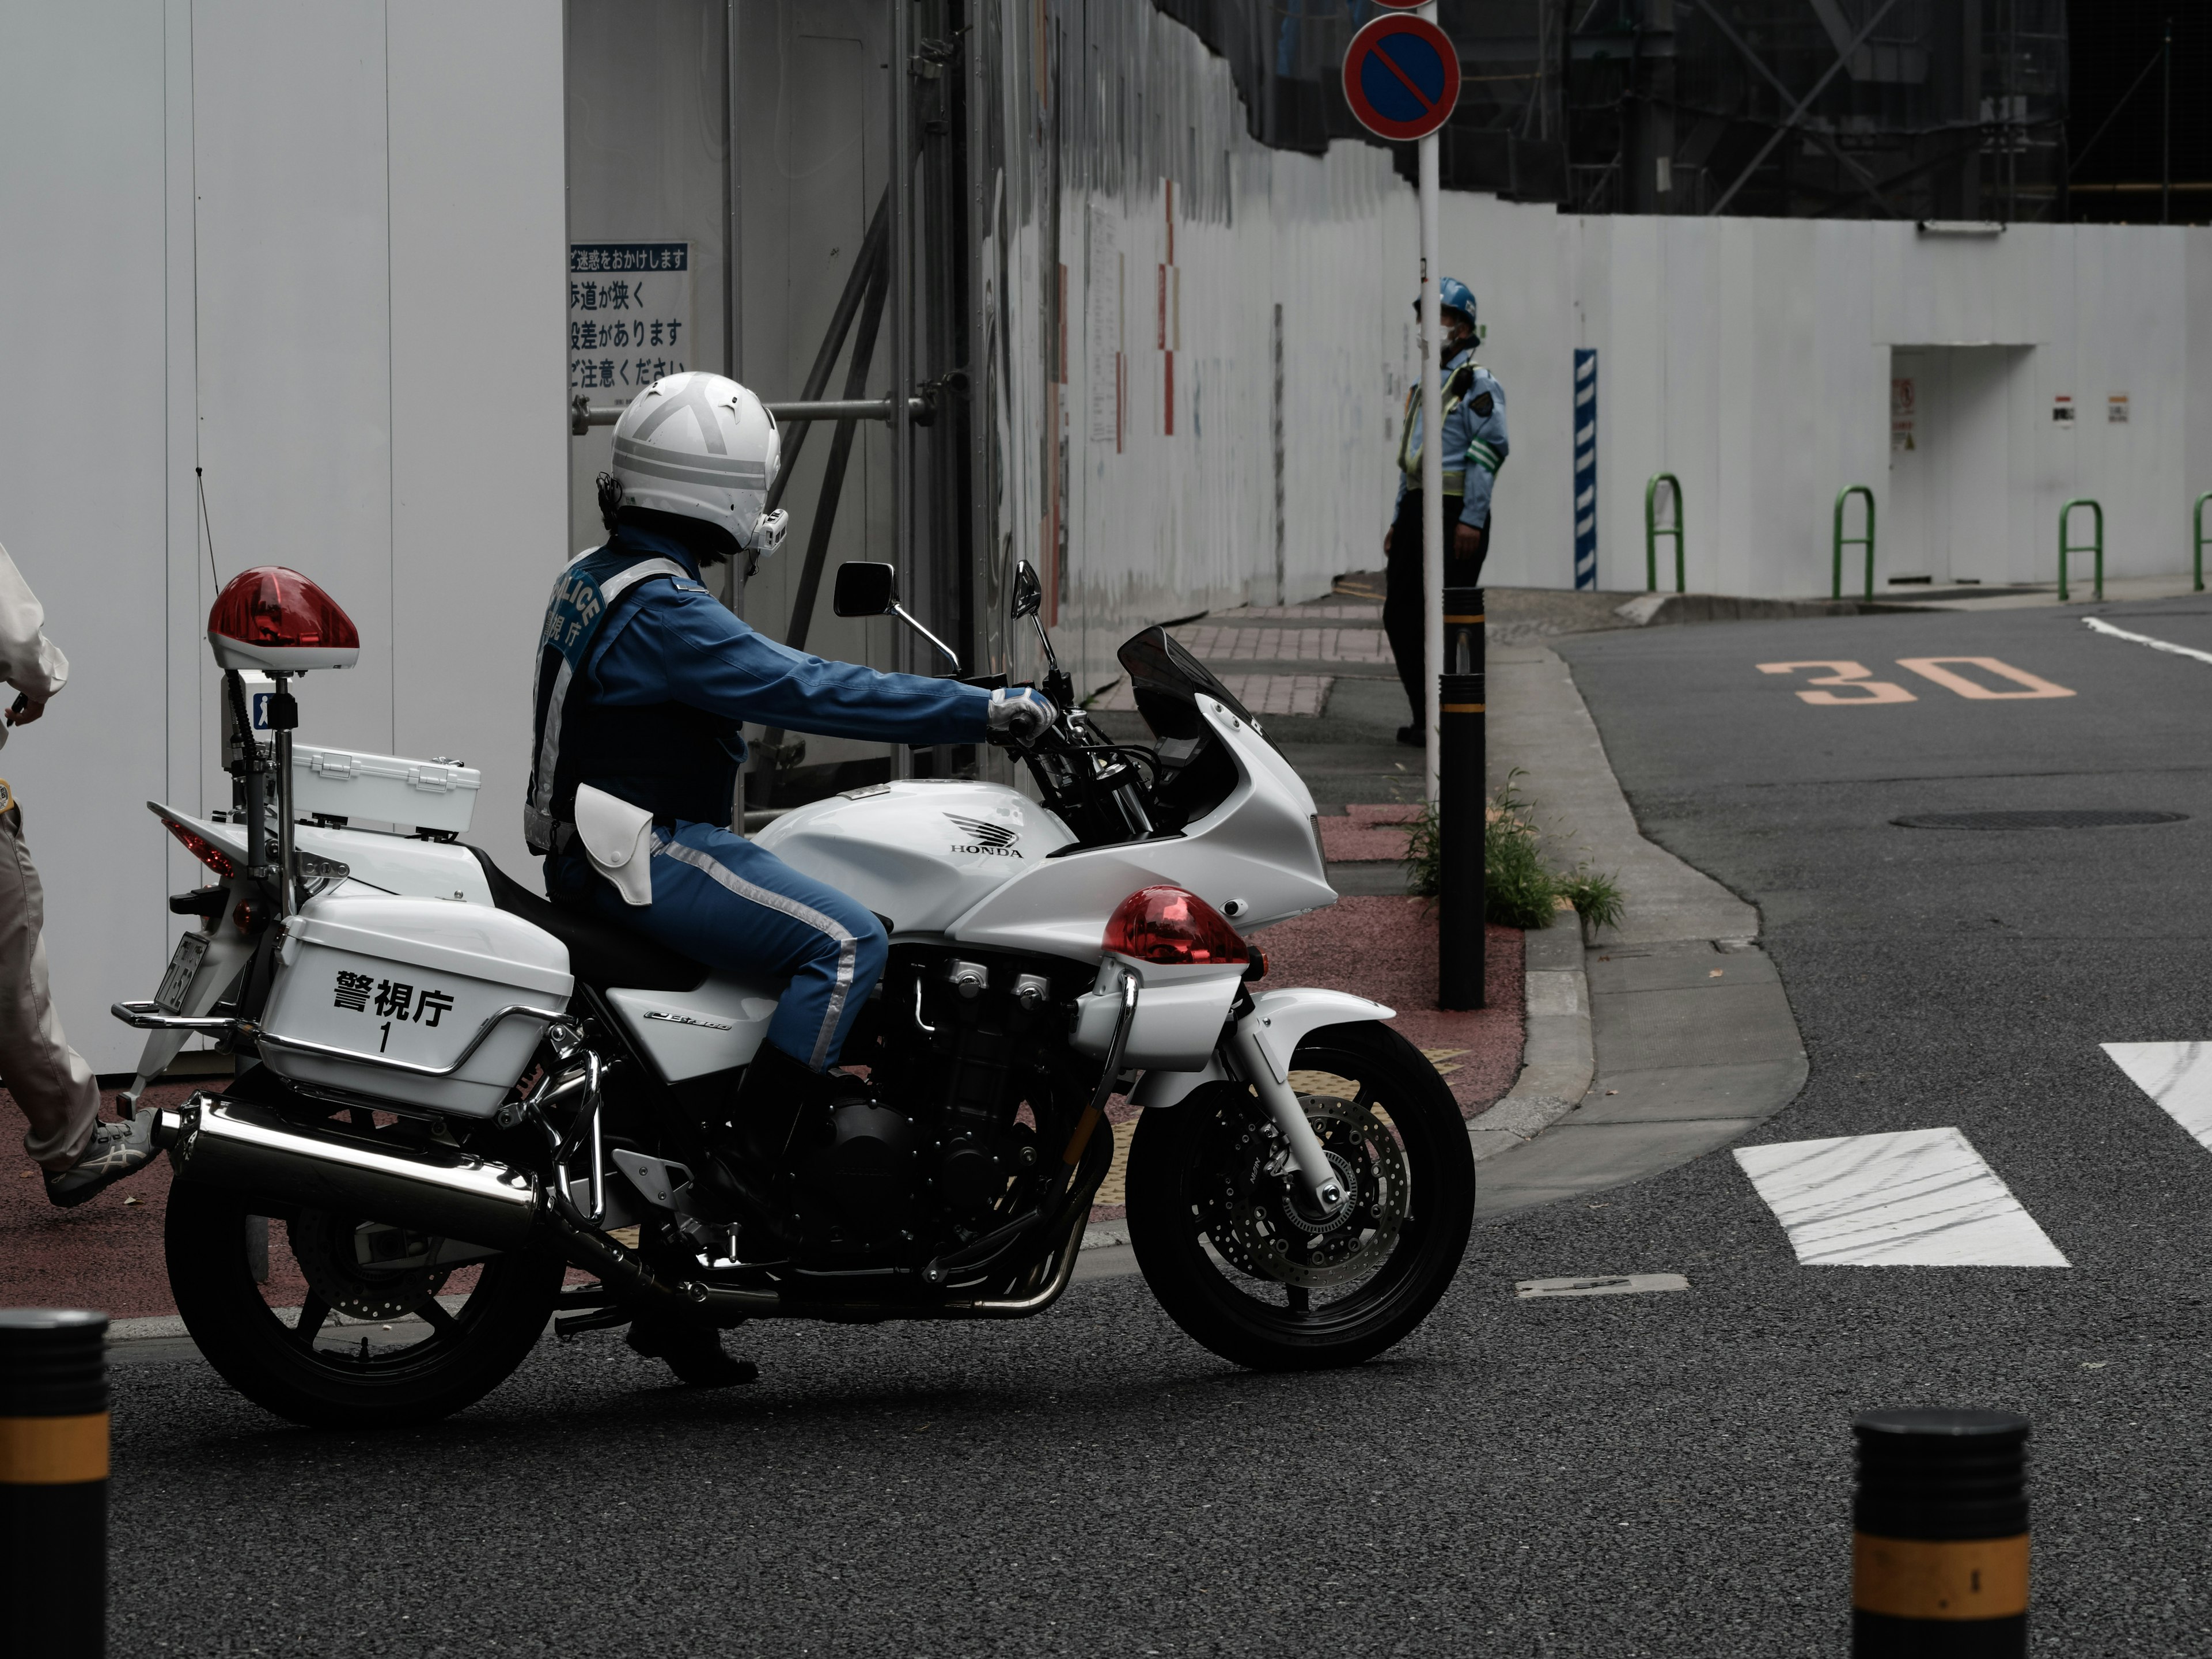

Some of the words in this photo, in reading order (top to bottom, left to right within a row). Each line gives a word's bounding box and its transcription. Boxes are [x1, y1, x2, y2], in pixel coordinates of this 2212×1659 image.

[1753, 657, 2077, 704] 30
[950, 844, 1024, 859] HONDA
[334, 970, 454, 1028] 警視庁
[643, 1010, 732, 1031] CB1300
[380, 1021, 392, 1053] 1
